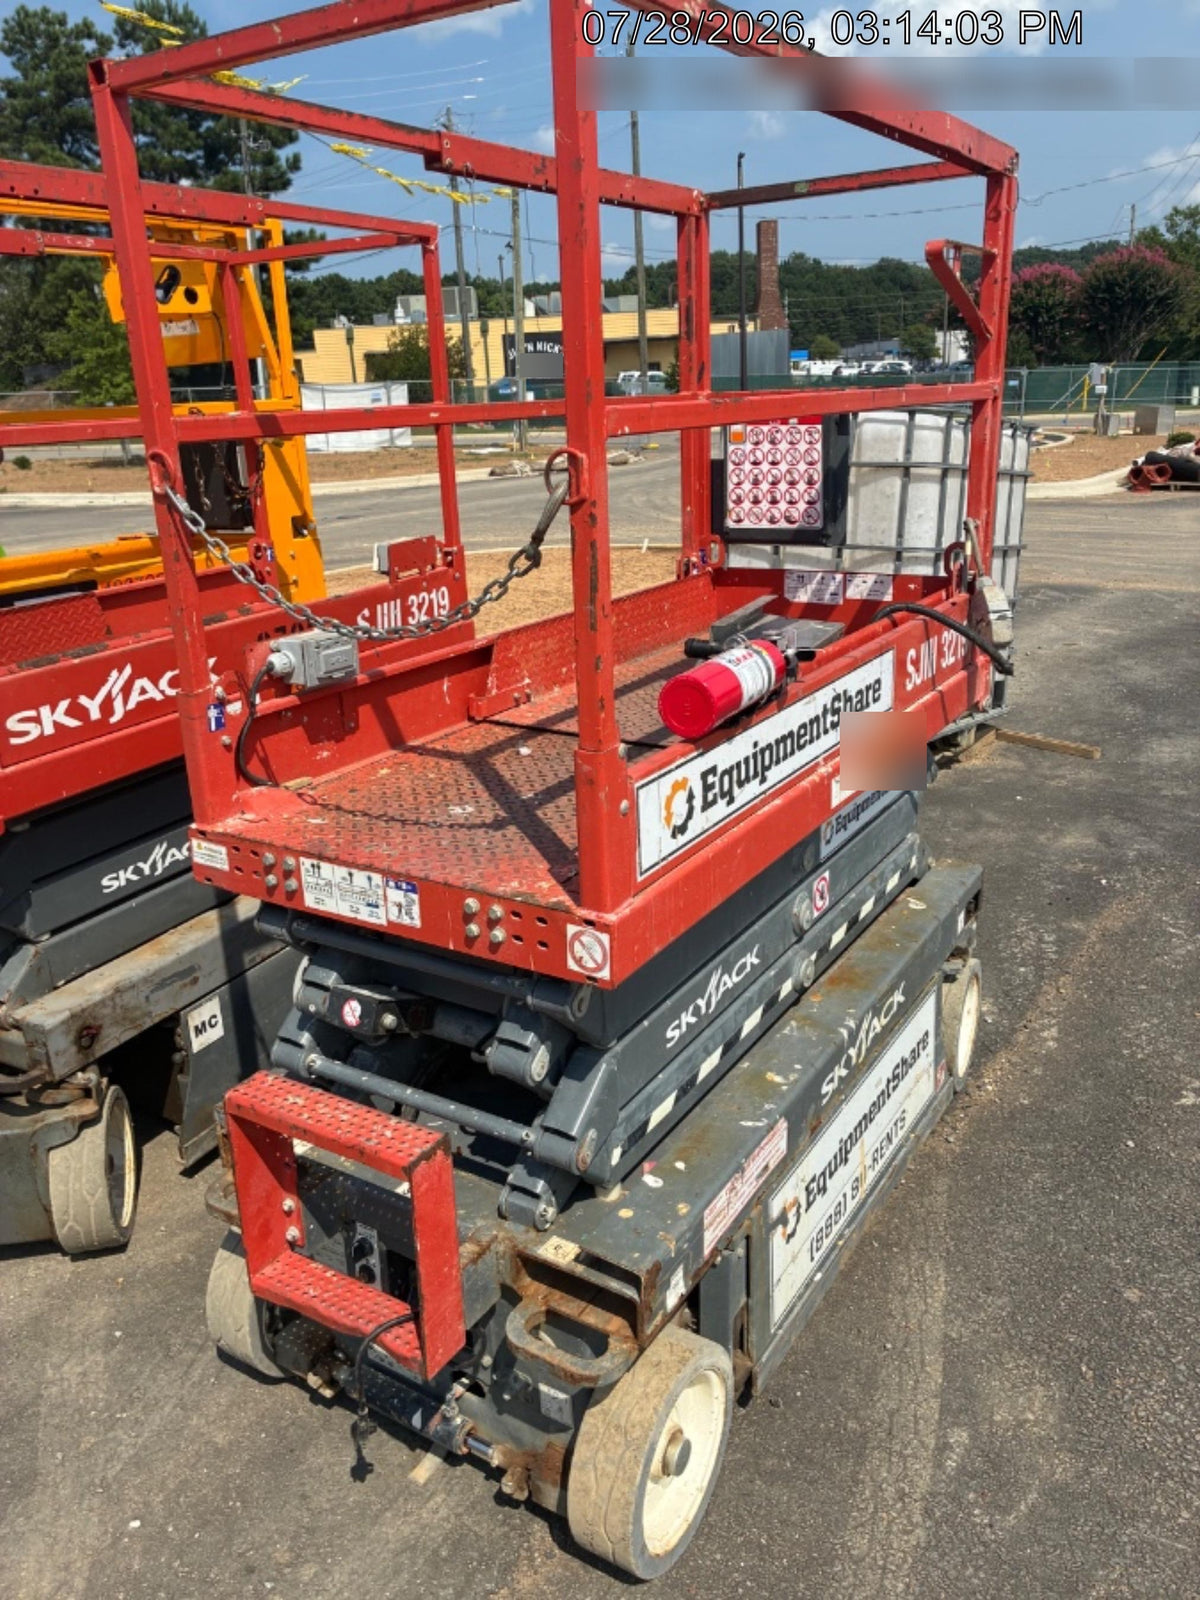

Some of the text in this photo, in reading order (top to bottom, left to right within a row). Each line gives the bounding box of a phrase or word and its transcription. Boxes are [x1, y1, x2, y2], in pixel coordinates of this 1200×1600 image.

[407, 586, 450, 626] 3219
[699, 677, 882, 814] EquipmentShare
[100, 841, 191, 894] SKYJAC
[193, 1014, 219, 1039] MC
[665, 943, 761, 1049] SKYJACK
[820, 979, 906, 1107] SKYJACK
[804, 1029, 930, 1214] EquipmentShare
